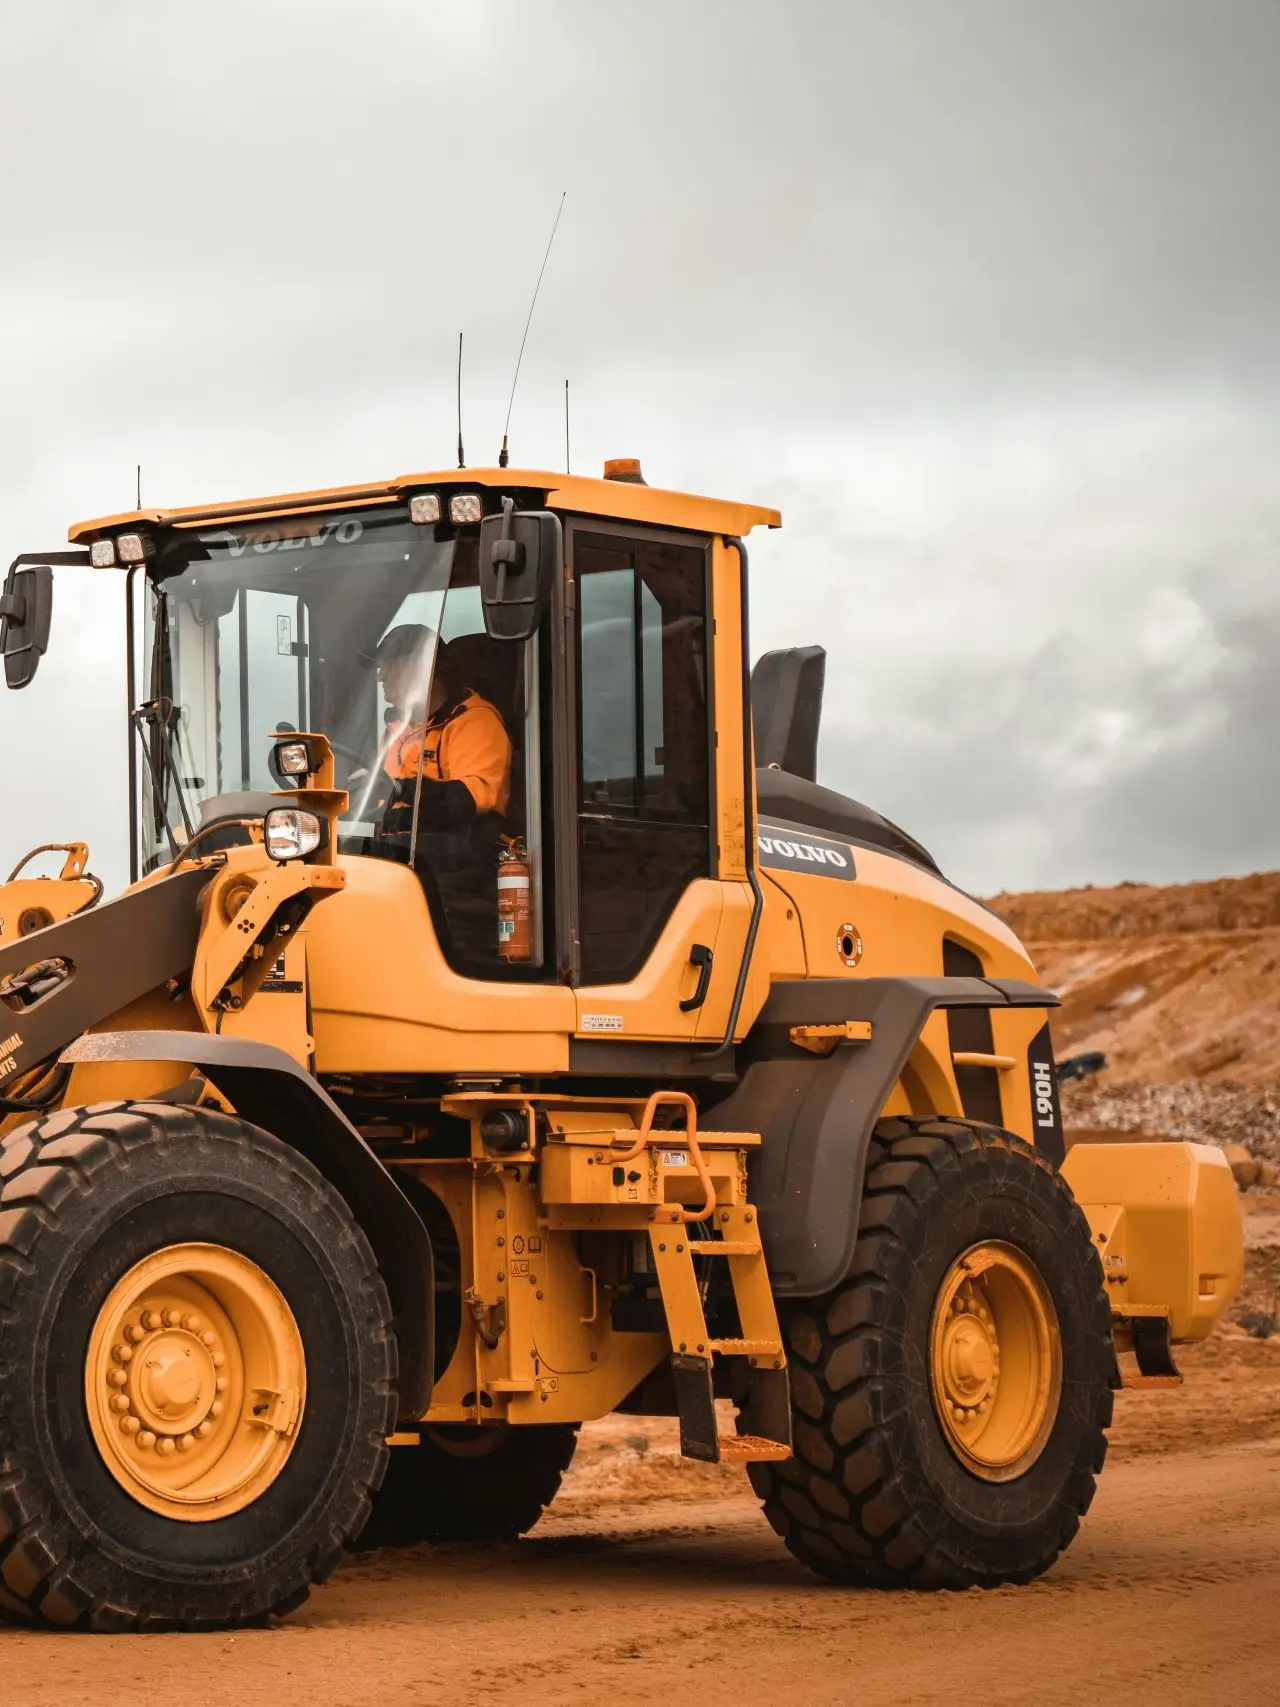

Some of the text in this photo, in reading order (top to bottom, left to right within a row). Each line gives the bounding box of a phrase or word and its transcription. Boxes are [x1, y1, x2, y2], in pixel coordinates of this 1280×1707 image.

[226, 520, 363, 557] VOLVO
[758, 836, 848, 868] VOLVO
[1033, 1062, 1054, 1128] L90H
